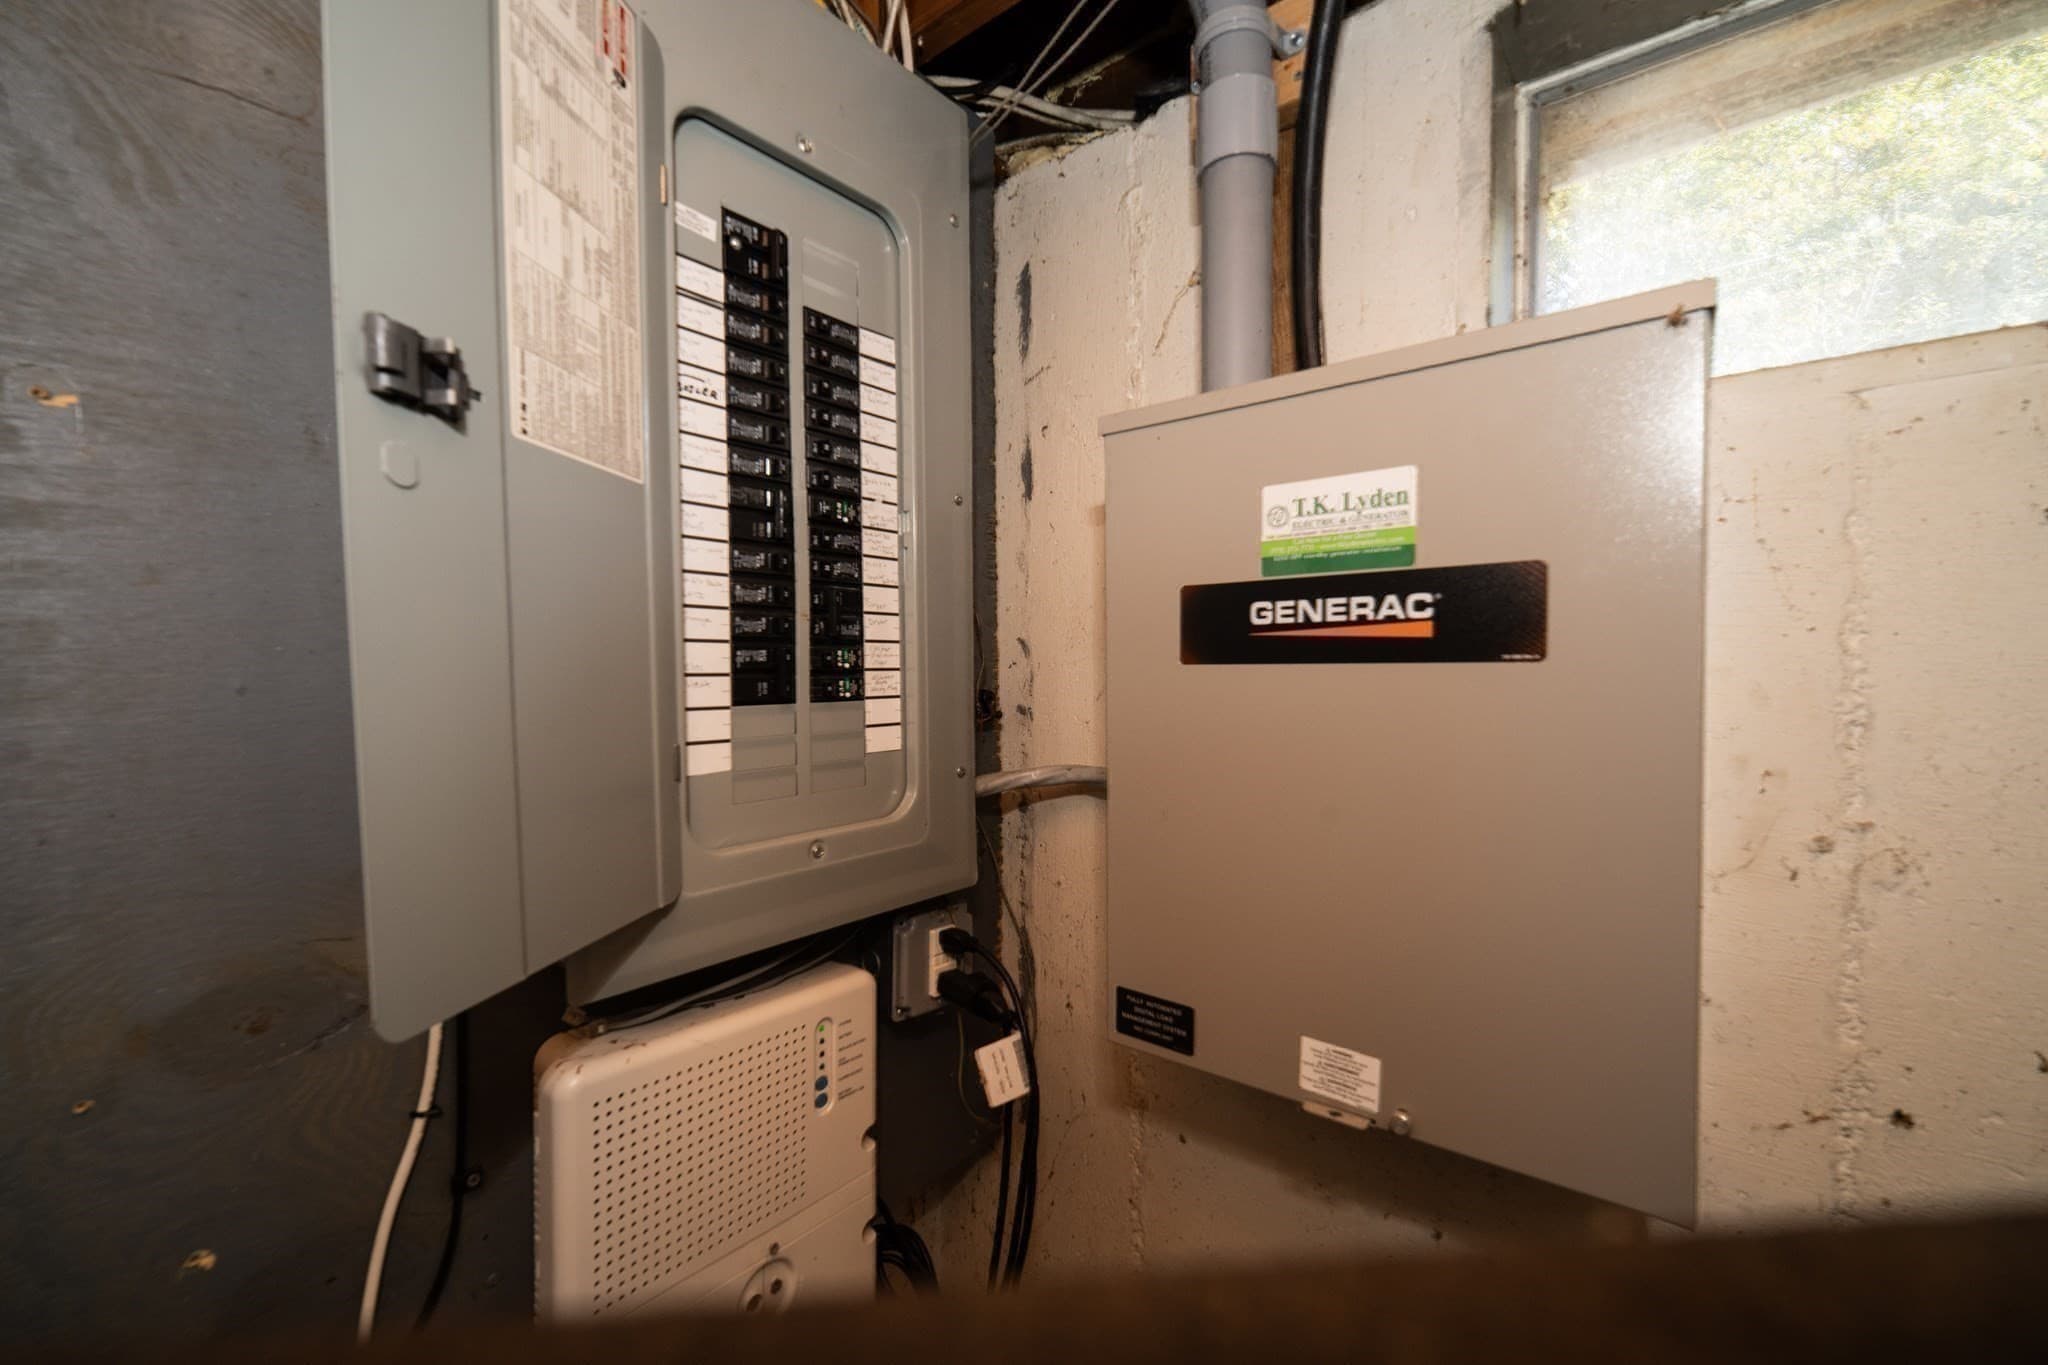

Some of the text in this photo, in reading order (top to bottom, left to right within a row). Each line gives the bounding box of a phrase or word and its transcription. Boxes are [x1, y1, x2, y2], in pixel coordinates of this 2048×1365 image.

[1292, 488, 1410, 517] T.K. Lyden
[1249, 592, 1435, 626] GENERAC
